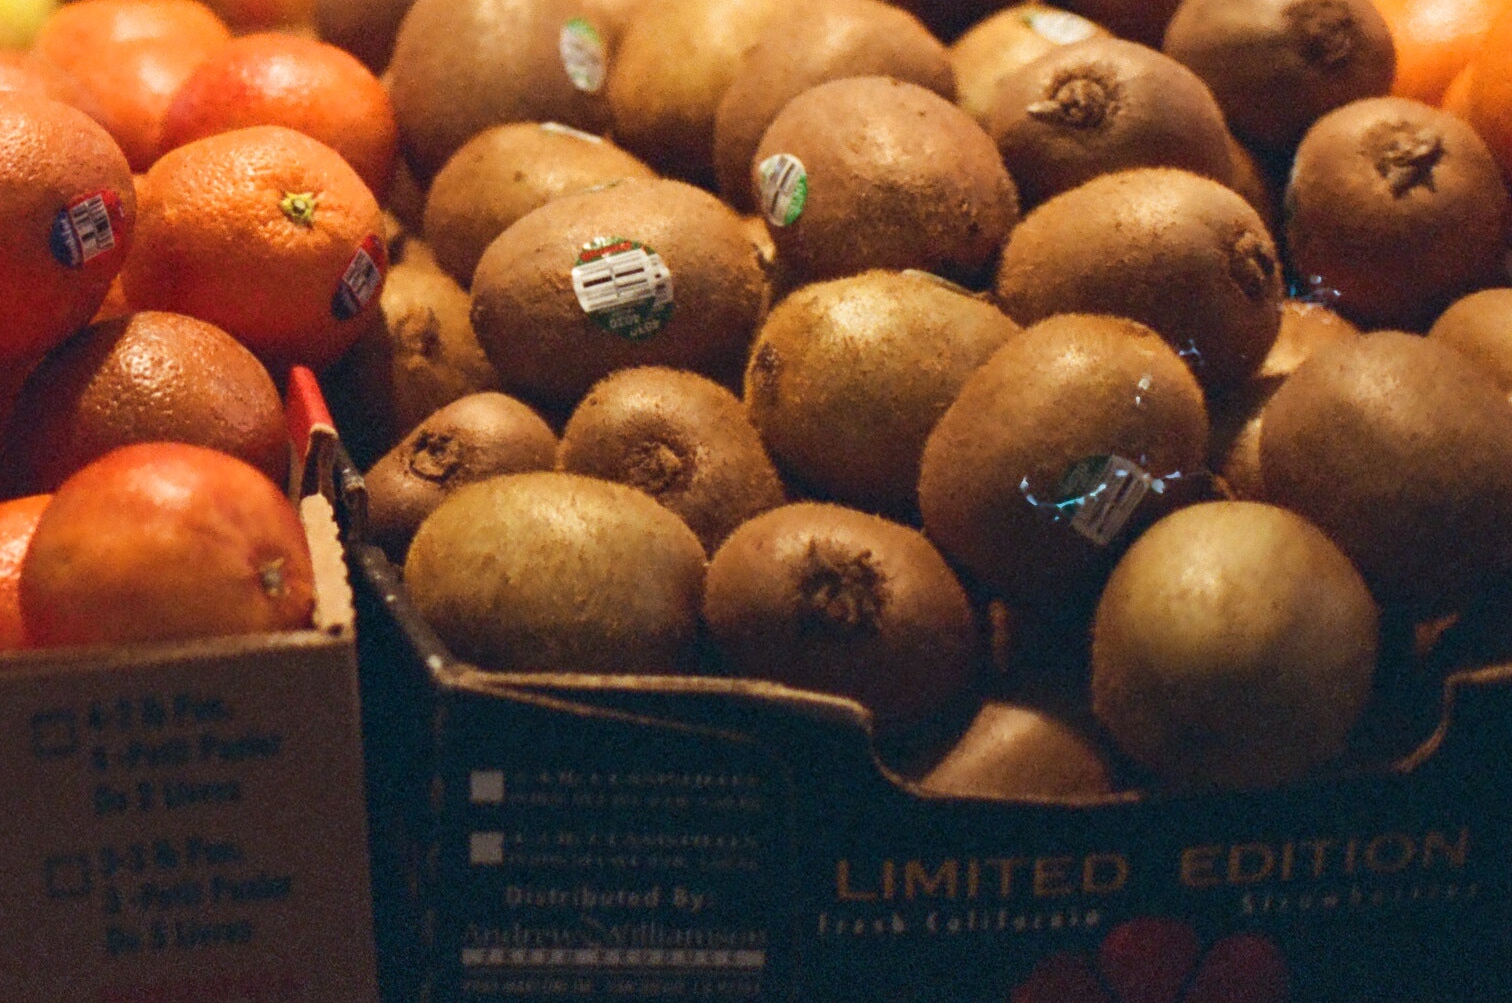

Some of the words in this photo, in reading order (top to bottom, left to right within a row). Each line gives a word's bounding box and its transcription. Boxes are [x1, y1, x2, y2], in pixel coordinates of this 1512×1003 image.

[837, 853, 1129, 901] LIMITED
[1180, 826, 1468, 887] EDITION
[504, 885, 661, 909] Distributed
[1240, 883, 1477, 915] Strawberries
[817, 911, 905, 936] Fresh
[925, 907, 1101, 934] California
